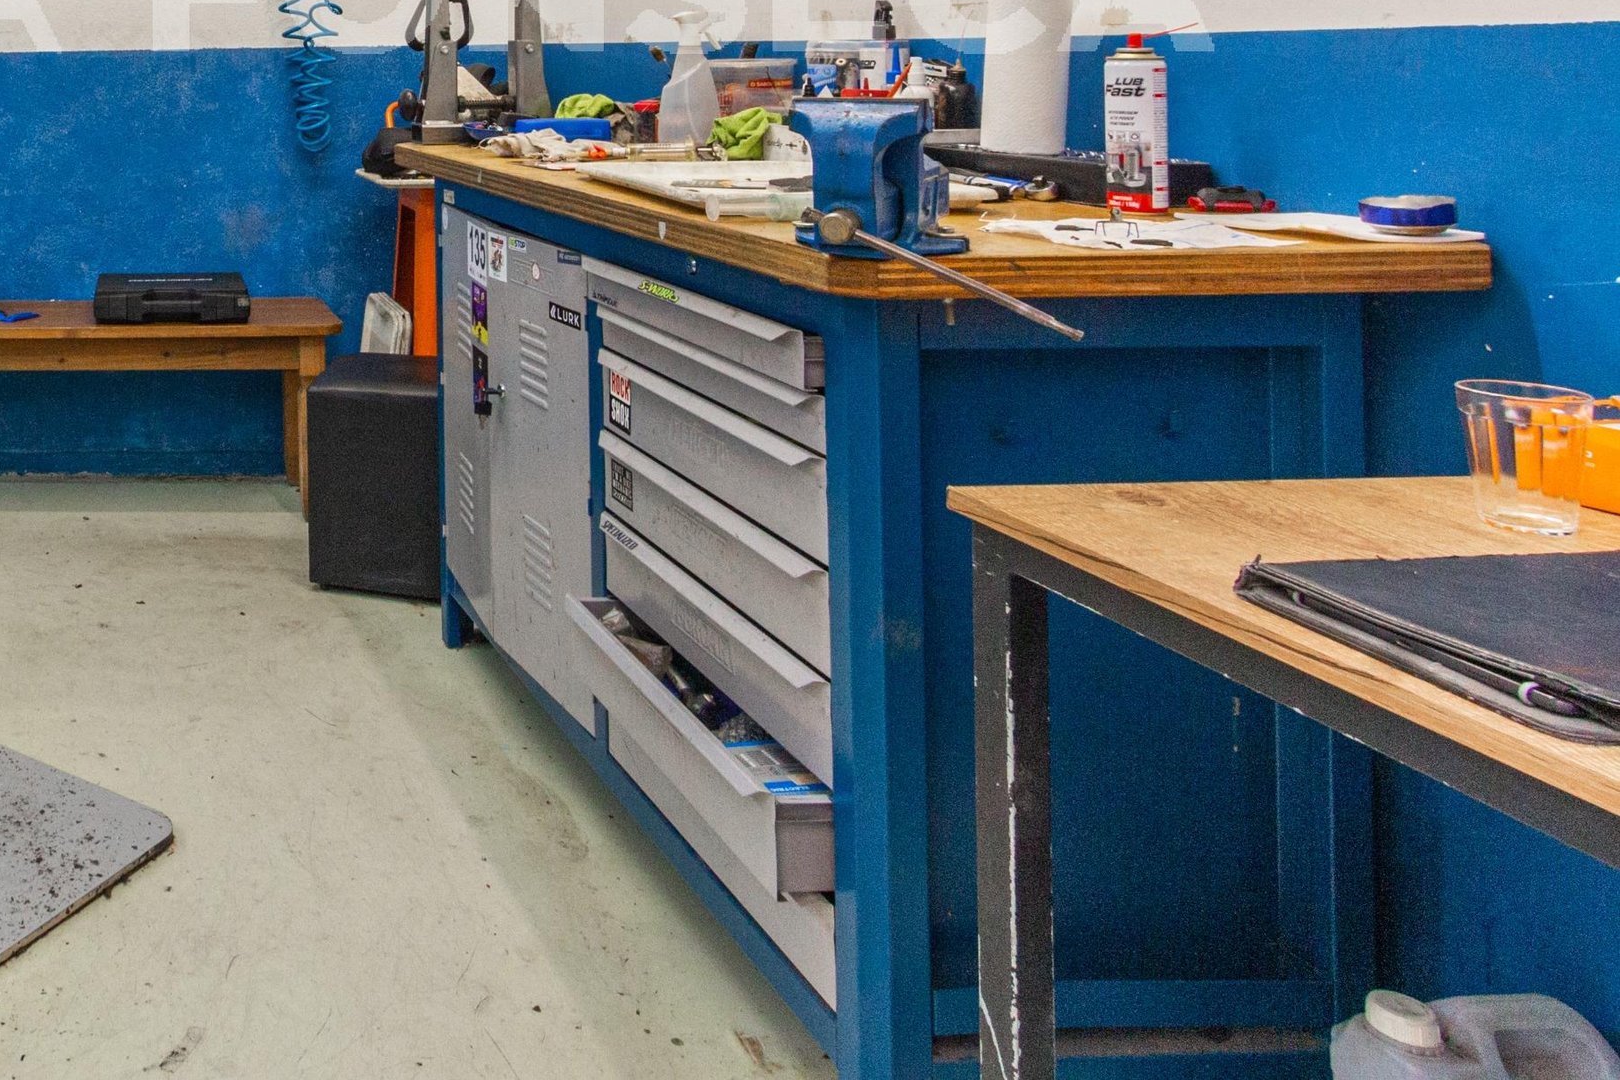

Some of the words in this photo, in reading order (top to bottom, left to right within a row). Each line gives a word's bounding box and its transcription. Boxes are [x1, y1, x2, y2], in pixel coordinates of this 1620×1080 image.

[1106, 85, 1145, 97] Fast
[1115, 77, 1144, 86] LUB
[469, 225, 486, 270] 135
[556, 309, 580, 328] LURK
[611, 370, 630, 396] ROCK
[611, 396, 630, 430] SHOX
[600, 519, 639, 551] SPECIALIZED
